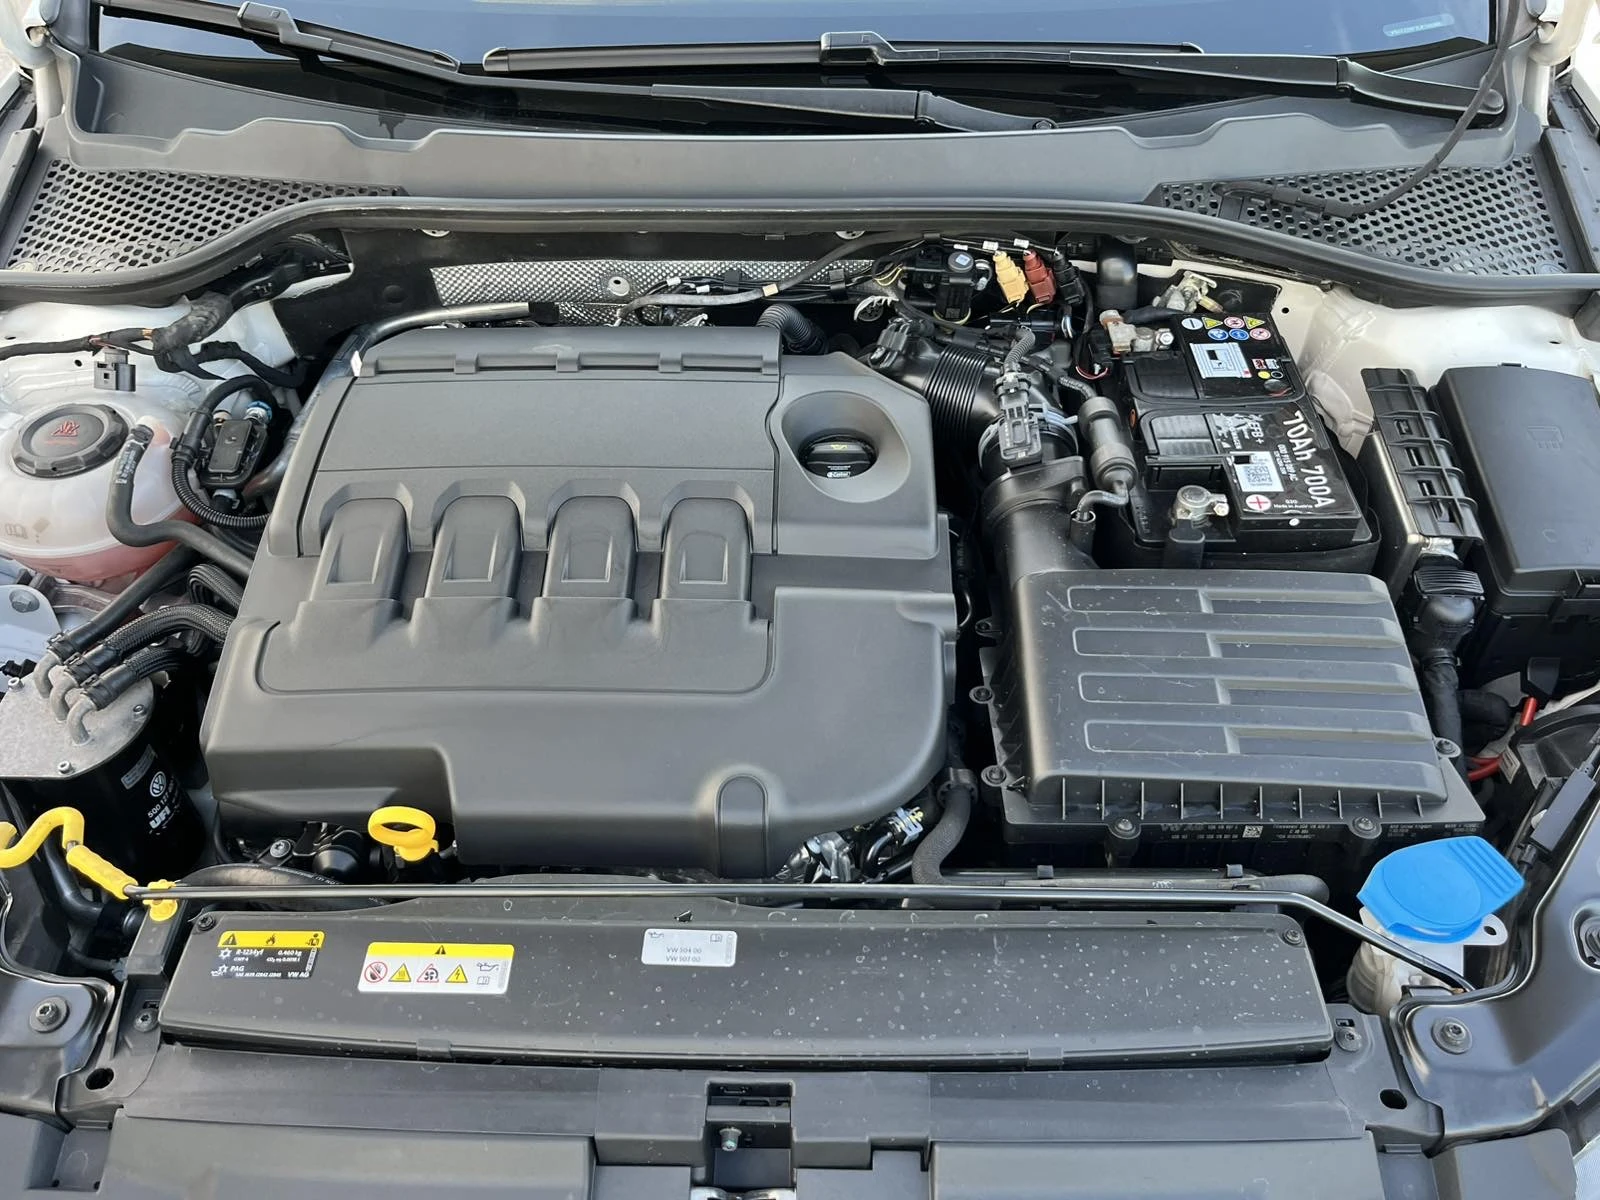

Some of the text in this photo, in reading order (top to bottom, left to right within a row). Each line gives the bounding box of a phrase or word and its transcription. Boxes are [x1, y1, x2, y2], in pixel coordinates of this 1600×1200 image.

[1283, 410, 1336, 508] 70Ah 700A
[149, 805, 171, 829] UFI
[235, 948, 264, 957] R-1234yf
